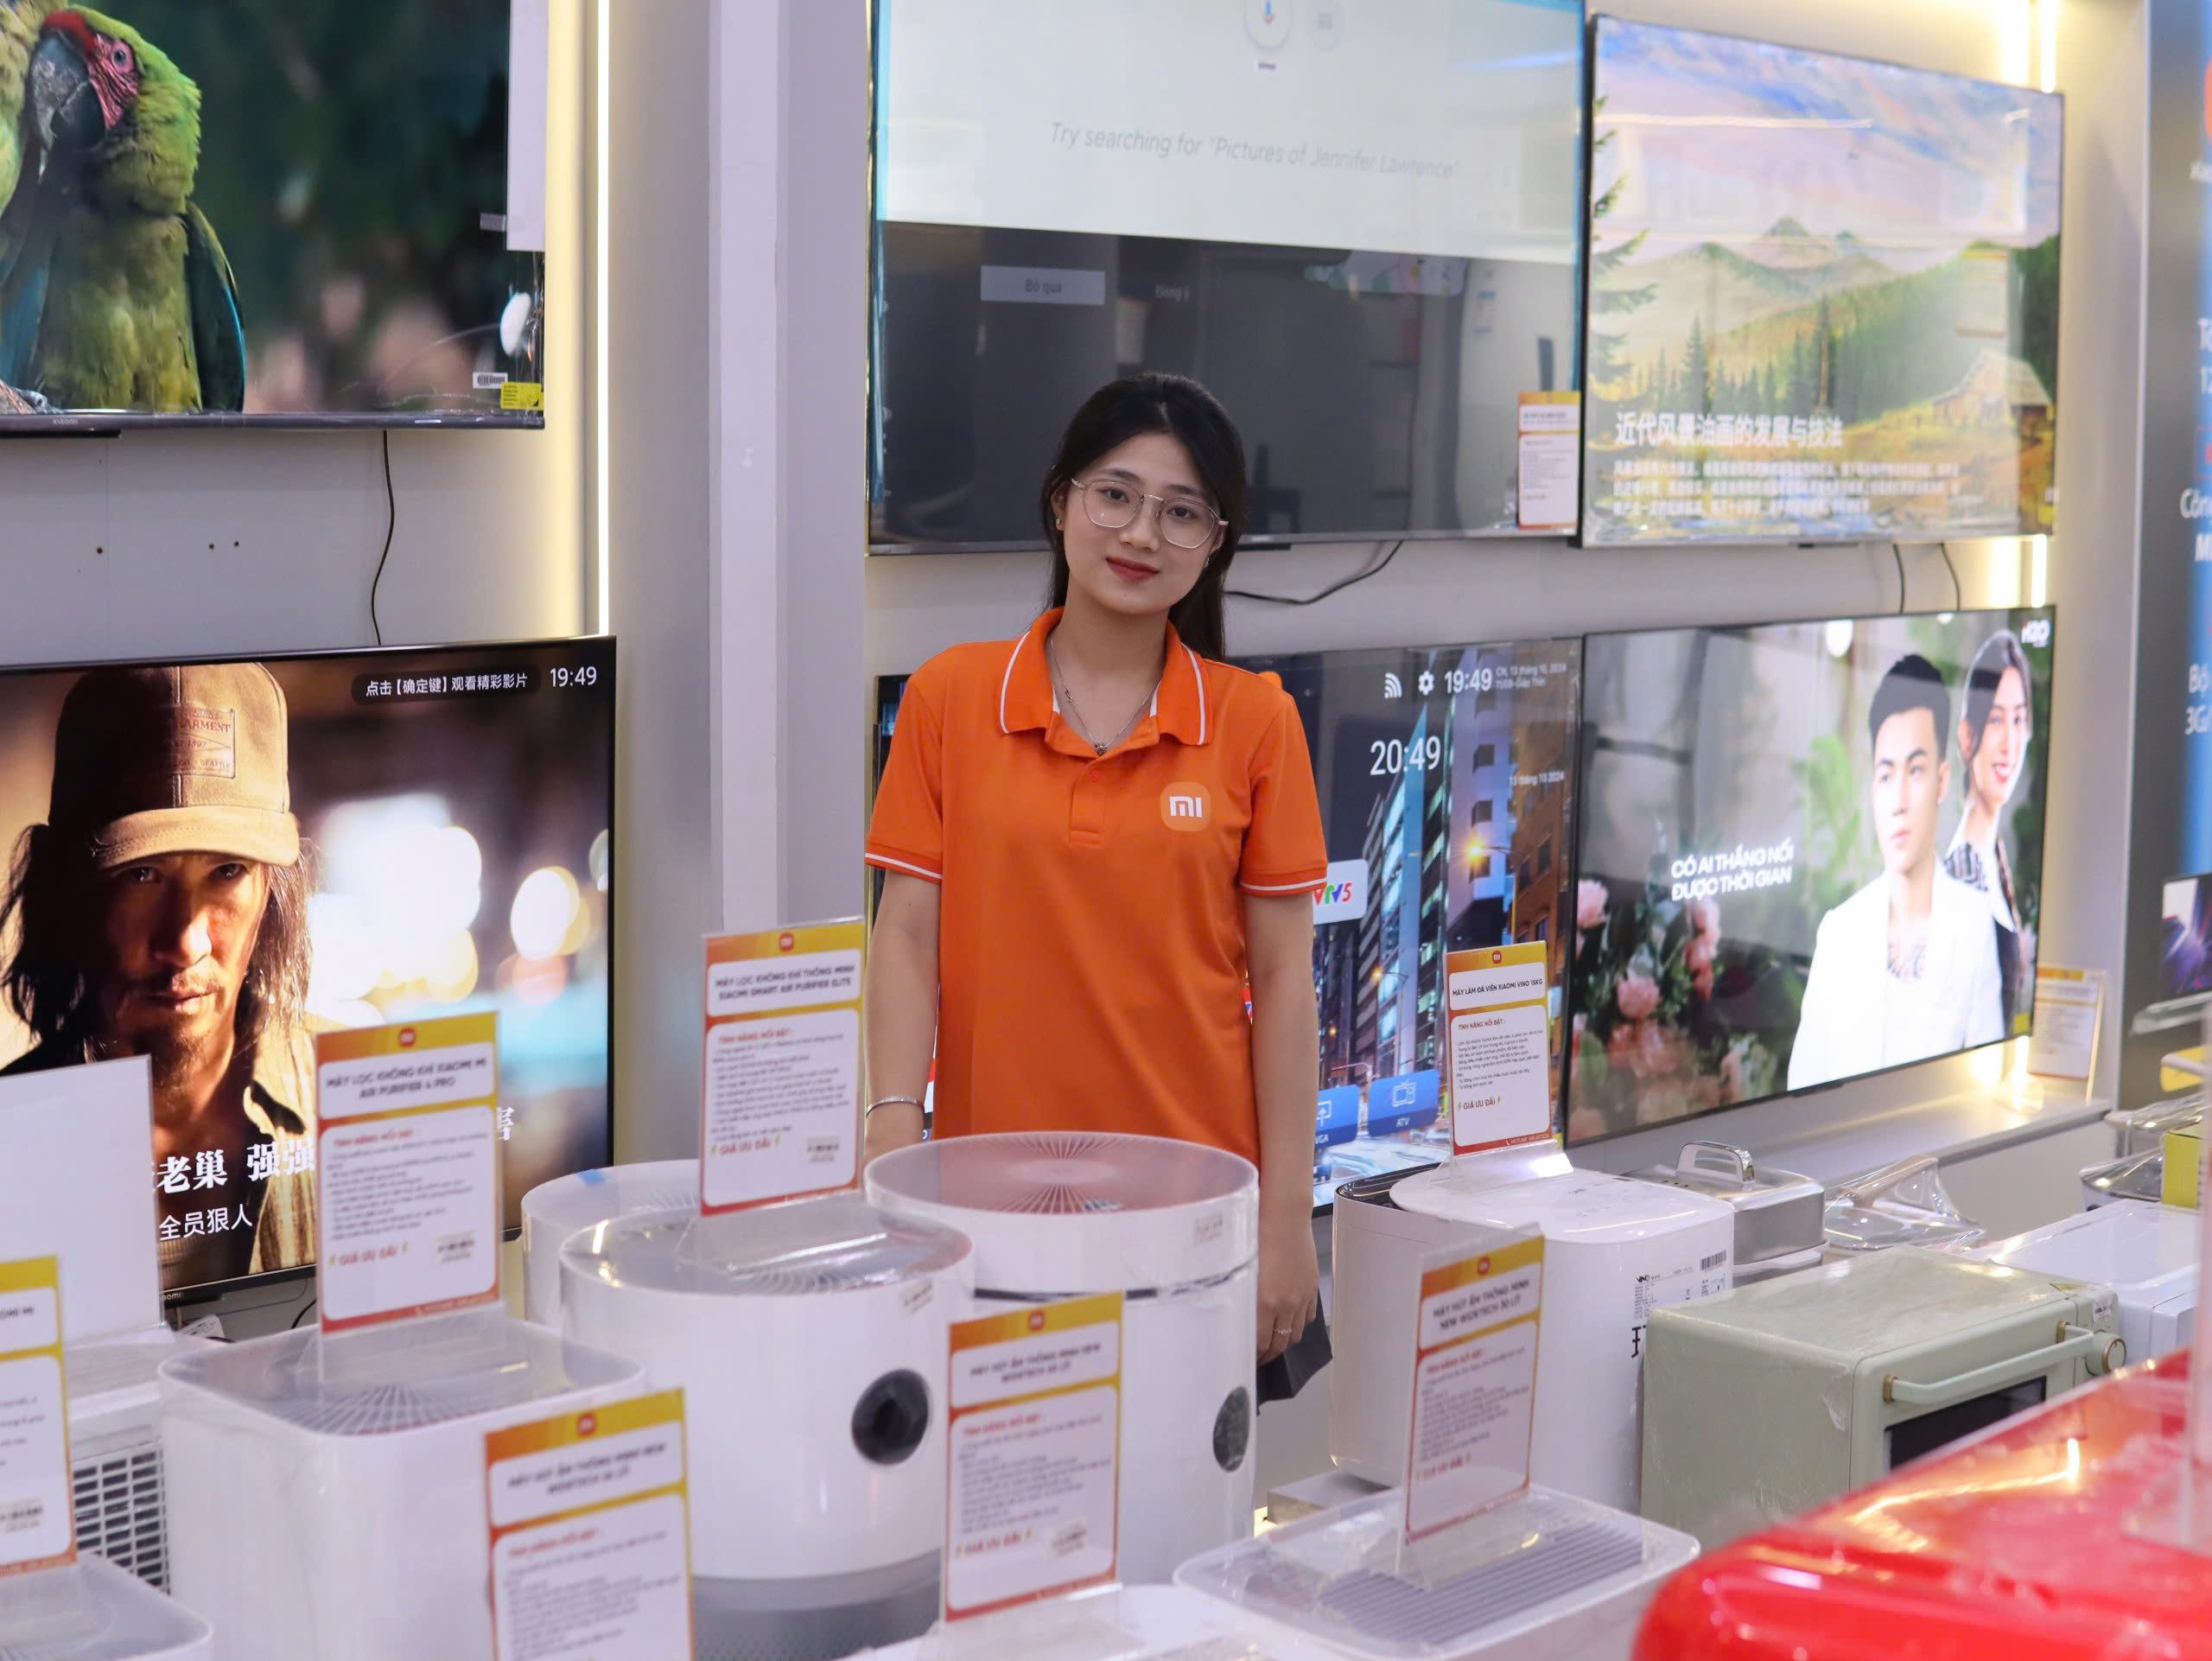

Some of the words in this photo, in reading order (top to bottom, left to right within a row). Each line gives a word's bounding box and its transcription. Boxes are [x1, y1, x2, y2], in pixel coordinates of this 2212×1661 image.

[1050, 121, 1081, 149] Try
[1084, 127, 1172, 159] searching
[1177, 132, 1203, 156] for
[1288, 145, 1306, 166] of
[1311, 147, 1376, 173] Jennifer
[1615, 410, 1845, 449] 近代风景油画的发展与技法
[365, 672, 528, 697] 点击【确定键】观看精彩影片
[550, 665, 597, 688] 19:49
[1444, 667, 1493, 694] 19:49
[1370, 735, 1441, 776] 20:49
[1671, 853, 1697, 879] CÓ
[1698, 856, 1713, 875] AI
[1715, 843, 1767, 872] THẮNG
[1768, 837, 1795, 864] NỔI
[1672, 875, 1719, 902] ĐƯỢC
[1719, 870, 1755, 894] THỜI
[1756, 865, 1793, 888] GIAN
[1452, 987, 1465, 996] MÁY
[1465, 985, 1476, 996] LÀM
[1477, 984, 1485, 994] ĐÁ
[1485, 983, 1497, 993] VIÊN
[1497, 982, 1516, 991] XIAOMI
[1516, 980, 1529, 989] VINO
[158, 1203, 252, 1242] 全员狠人
